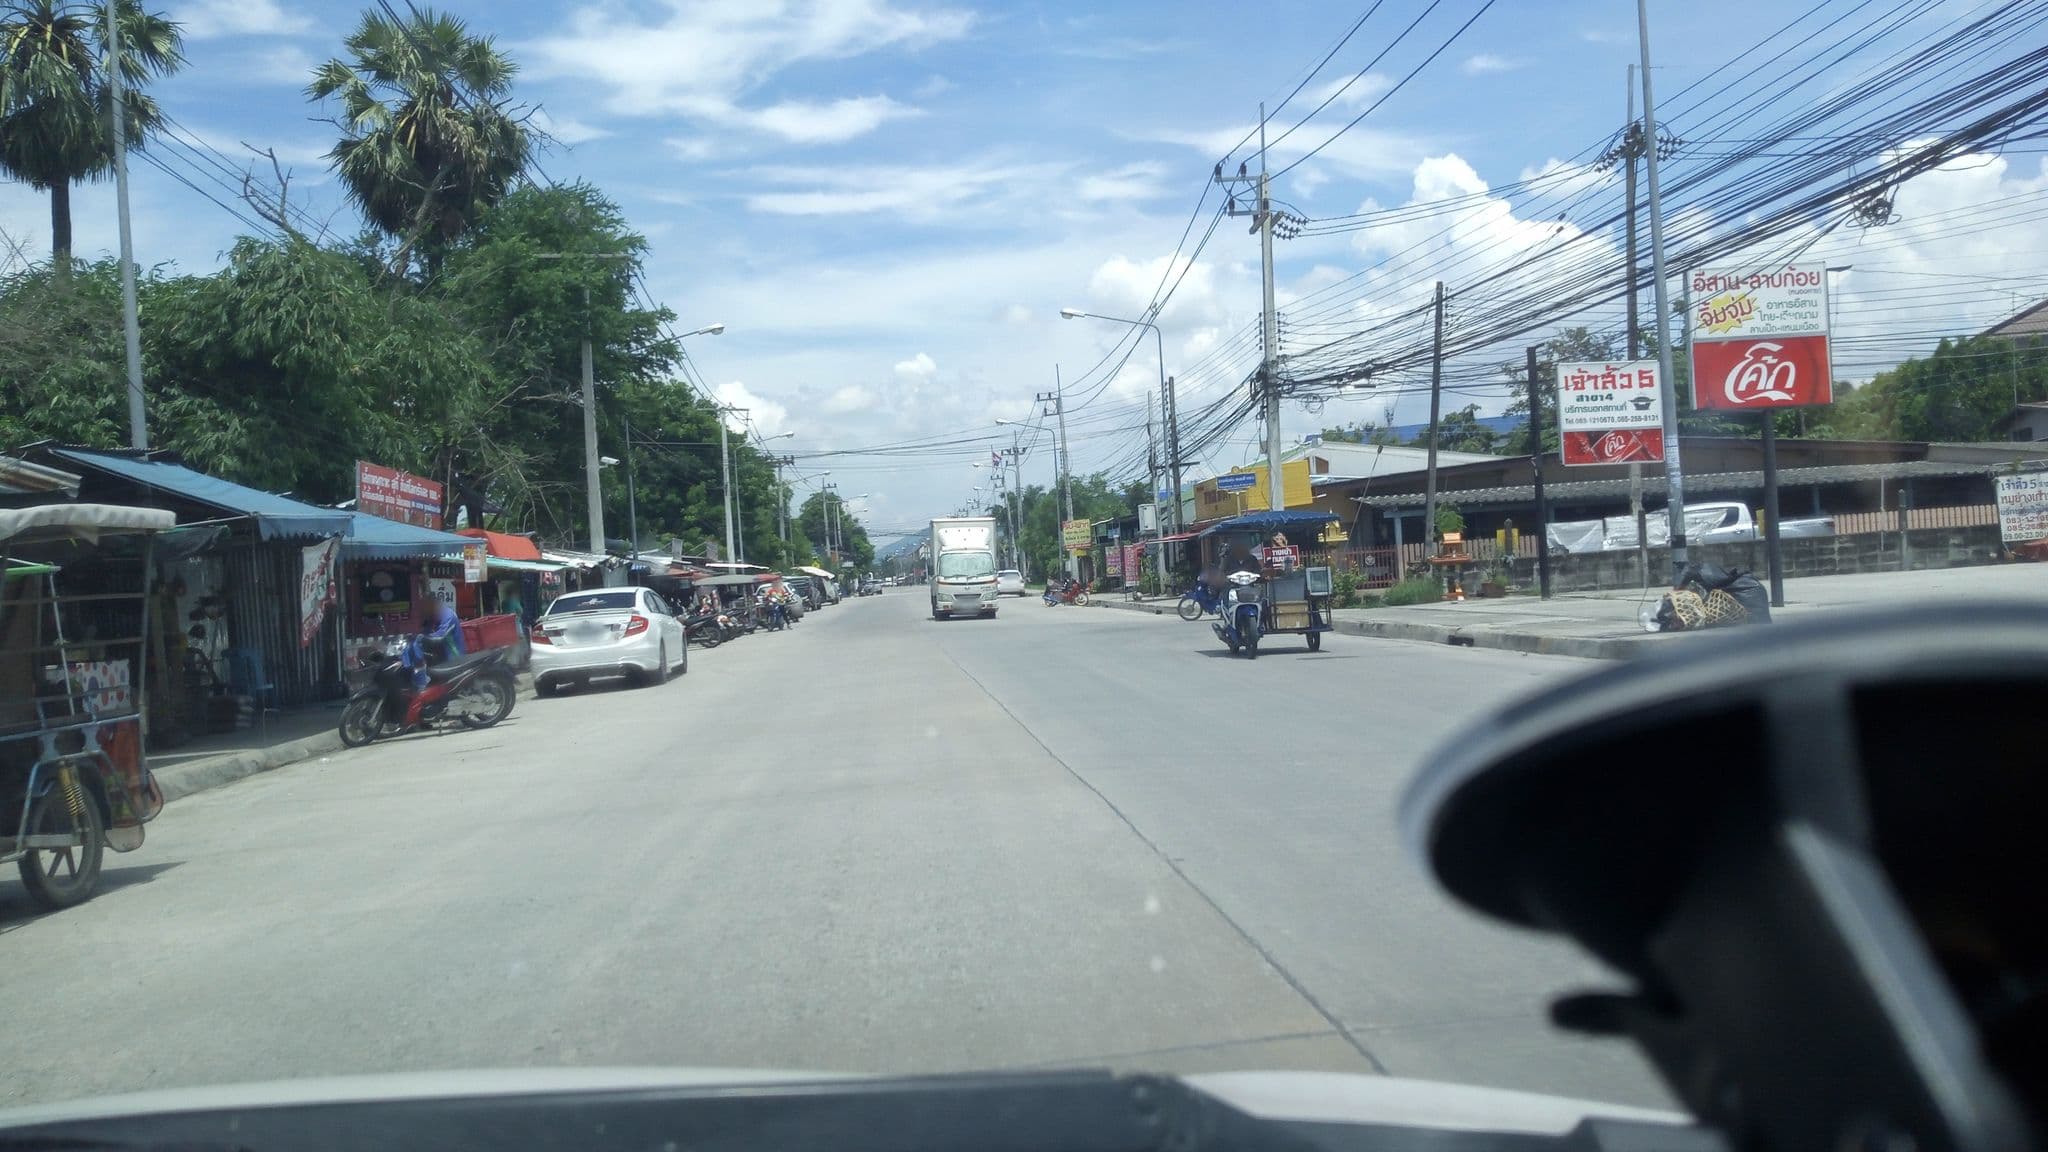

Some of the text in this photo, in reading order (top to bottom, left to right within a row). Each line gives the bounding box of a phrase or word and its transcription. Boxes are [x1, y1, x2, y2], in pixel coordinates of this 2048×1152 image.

[1637, 369, 1655, 389] 5
[1724, 342, 1797, 403] โค้ก
[2030, 479, 2037, 490] 5
